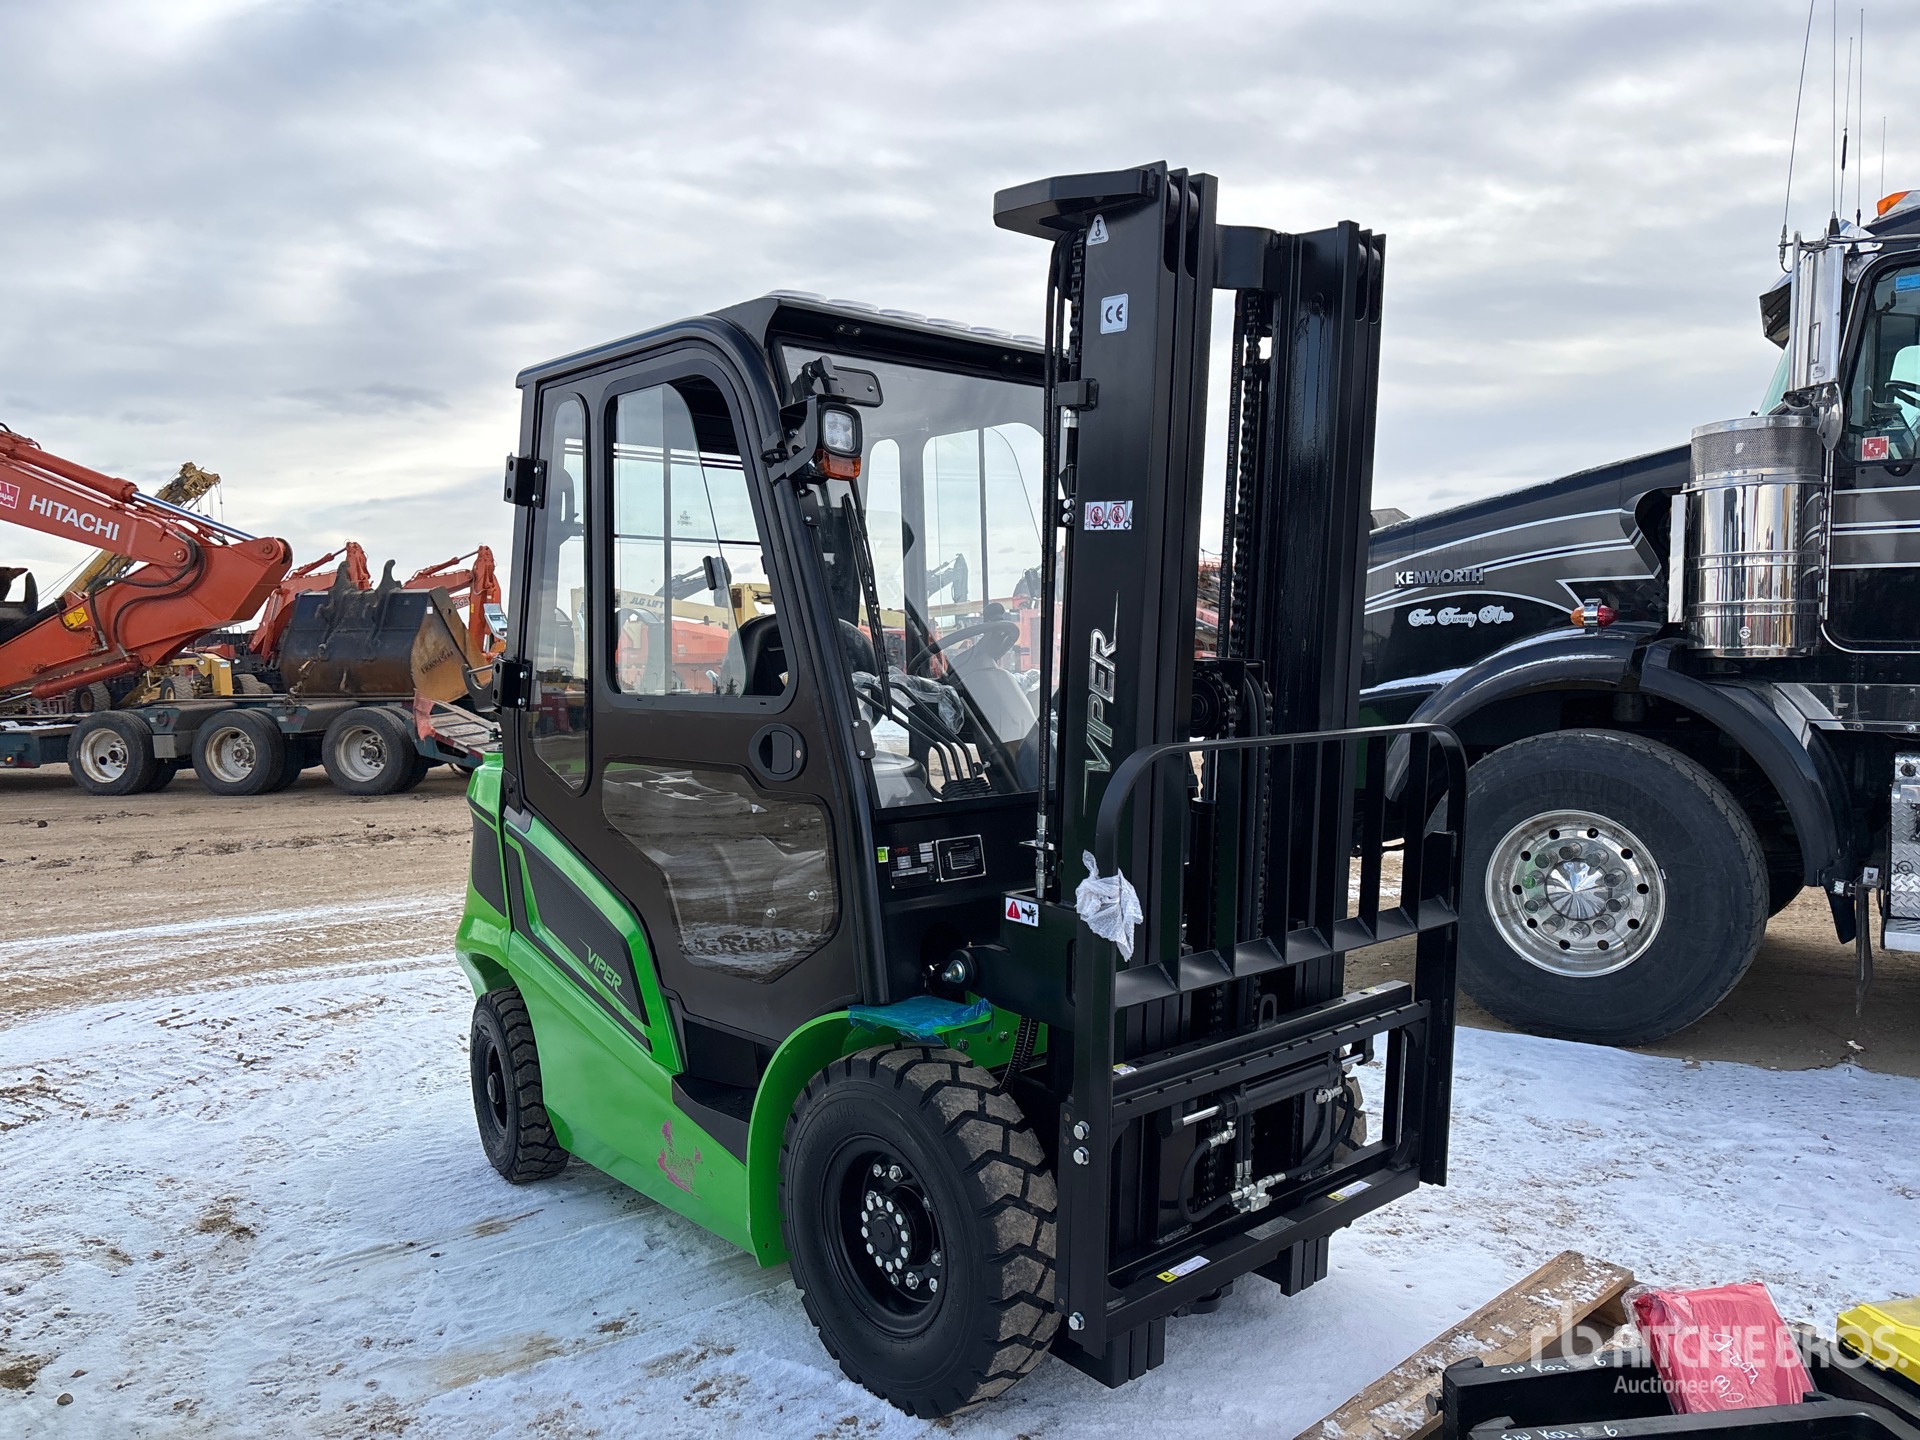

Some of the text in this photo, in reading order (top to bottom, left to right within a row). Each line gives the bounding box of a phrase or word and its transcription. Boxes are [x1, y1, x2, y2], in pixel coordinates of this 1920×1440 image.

[1105, 303, 1124, 324] CE
[29, 494, 119, 541] HITACHI
[1395, 568, 1484, 585] KENWORTH
[629, 596, 665, 609] JLG LIFT
[1085, 605, 1119, 792] VIPER
[583, 943, 626, 998] VIPER
